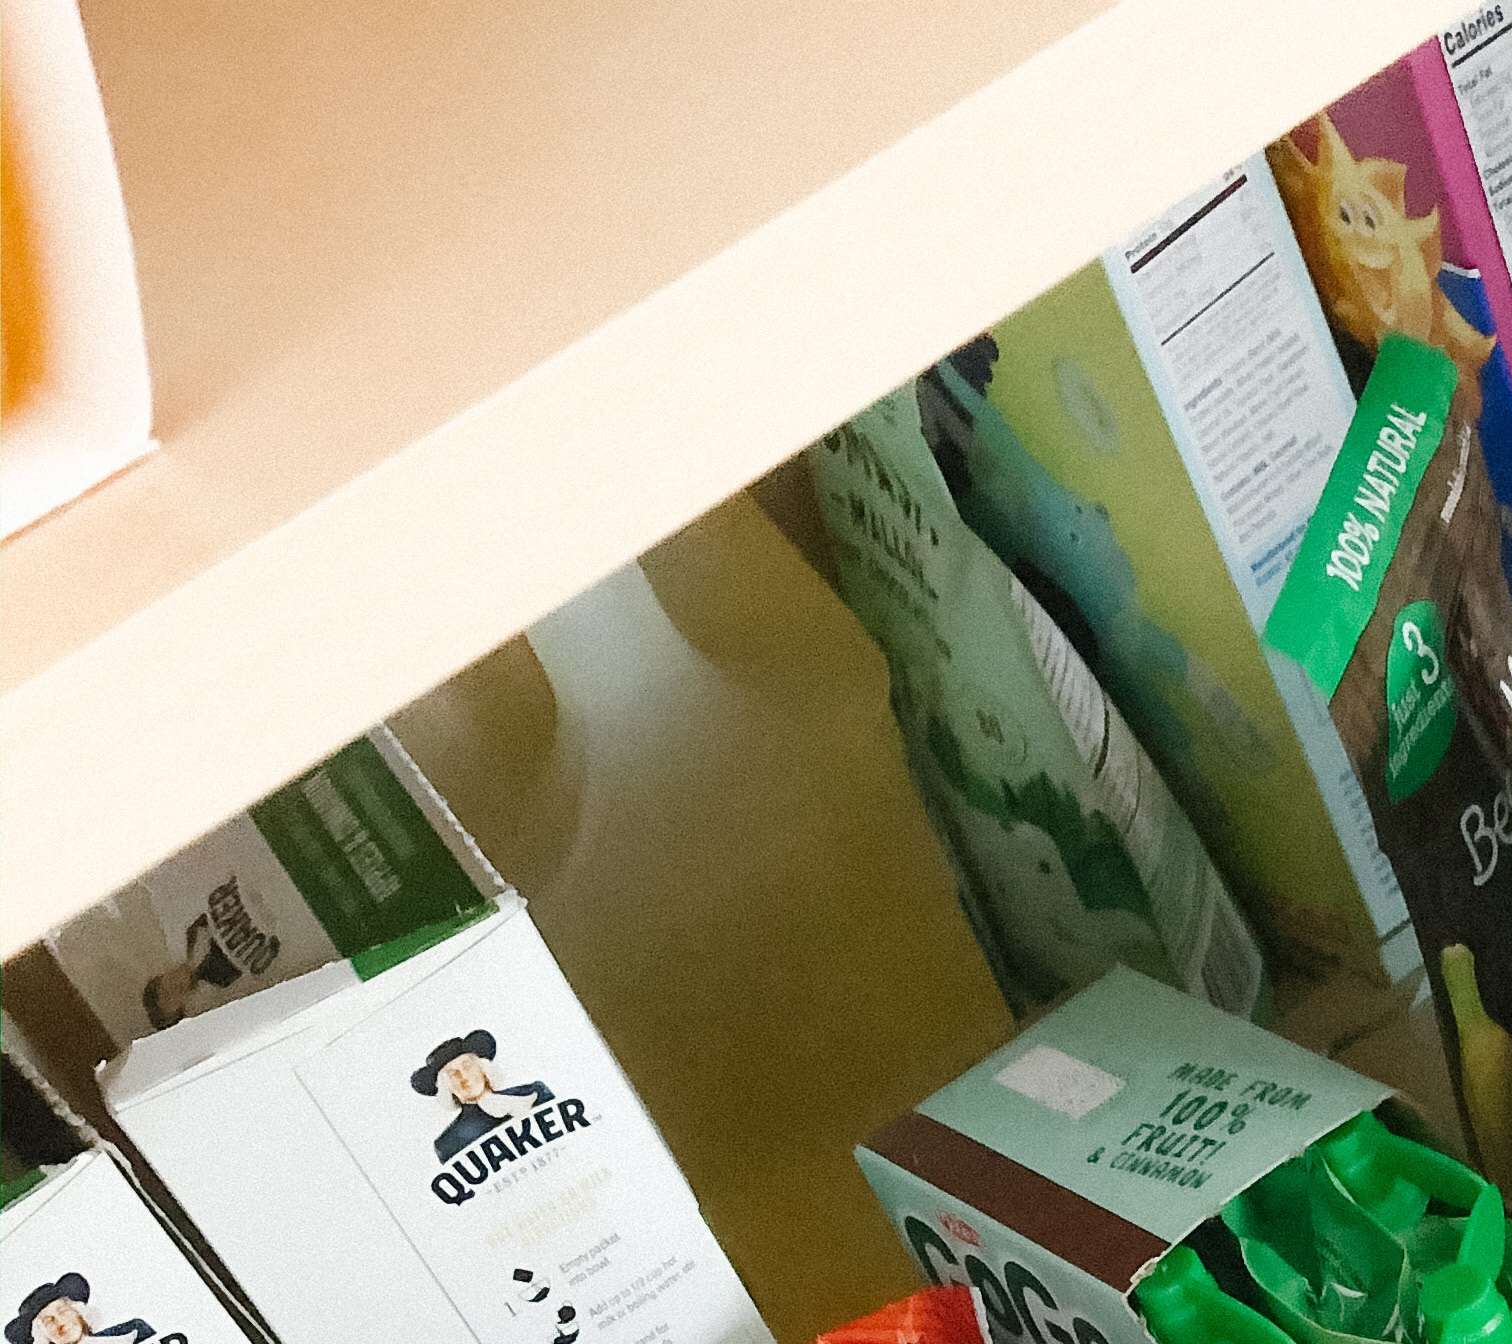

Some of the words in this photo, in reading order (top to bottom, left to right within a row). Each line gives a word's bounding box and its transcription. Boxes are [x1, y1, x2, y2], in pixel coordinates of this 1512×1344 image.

[1442, 1, 1505, 55] Calories
[1326, 511, 1380, 592] 100%
[1354, 402, 1428, 523] NATURAL
[1402, 621, 1440, 685] 3
[205, 874, 284, 978] QUAKER
[1156, 1090, 1256, 1137] 100%
[1166, 1062, 1238, 1095] MADE
[1239, 1075, 1312, 1113] FROM
[429, 1096, 594, 1209] QUAKER
[1120, 1121, 1226, 1166] FRUIT!
[1108, 1153, 1212, 1191] CINNAMON
